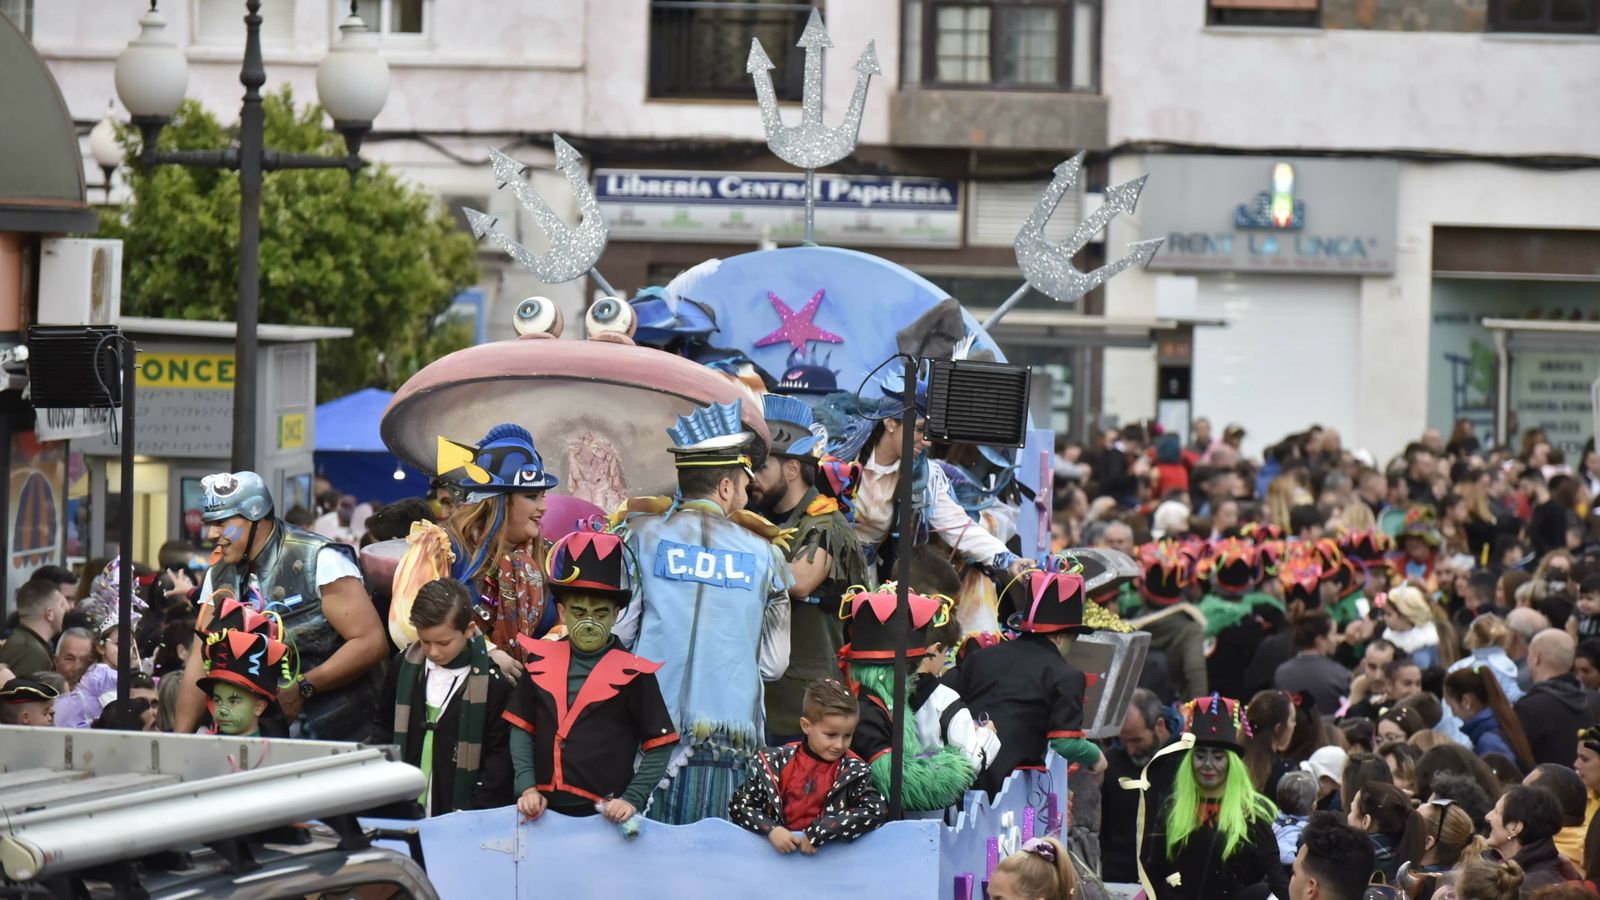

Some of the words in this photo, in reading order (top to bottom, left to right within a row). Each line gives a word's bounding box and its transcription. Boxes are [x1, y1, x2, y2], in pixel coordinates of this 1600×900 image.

[1246, 235, 1279, 255] LA
[142, 359, 235, 382] ONCE
[667, 548, 750, 584] C.D.L.
